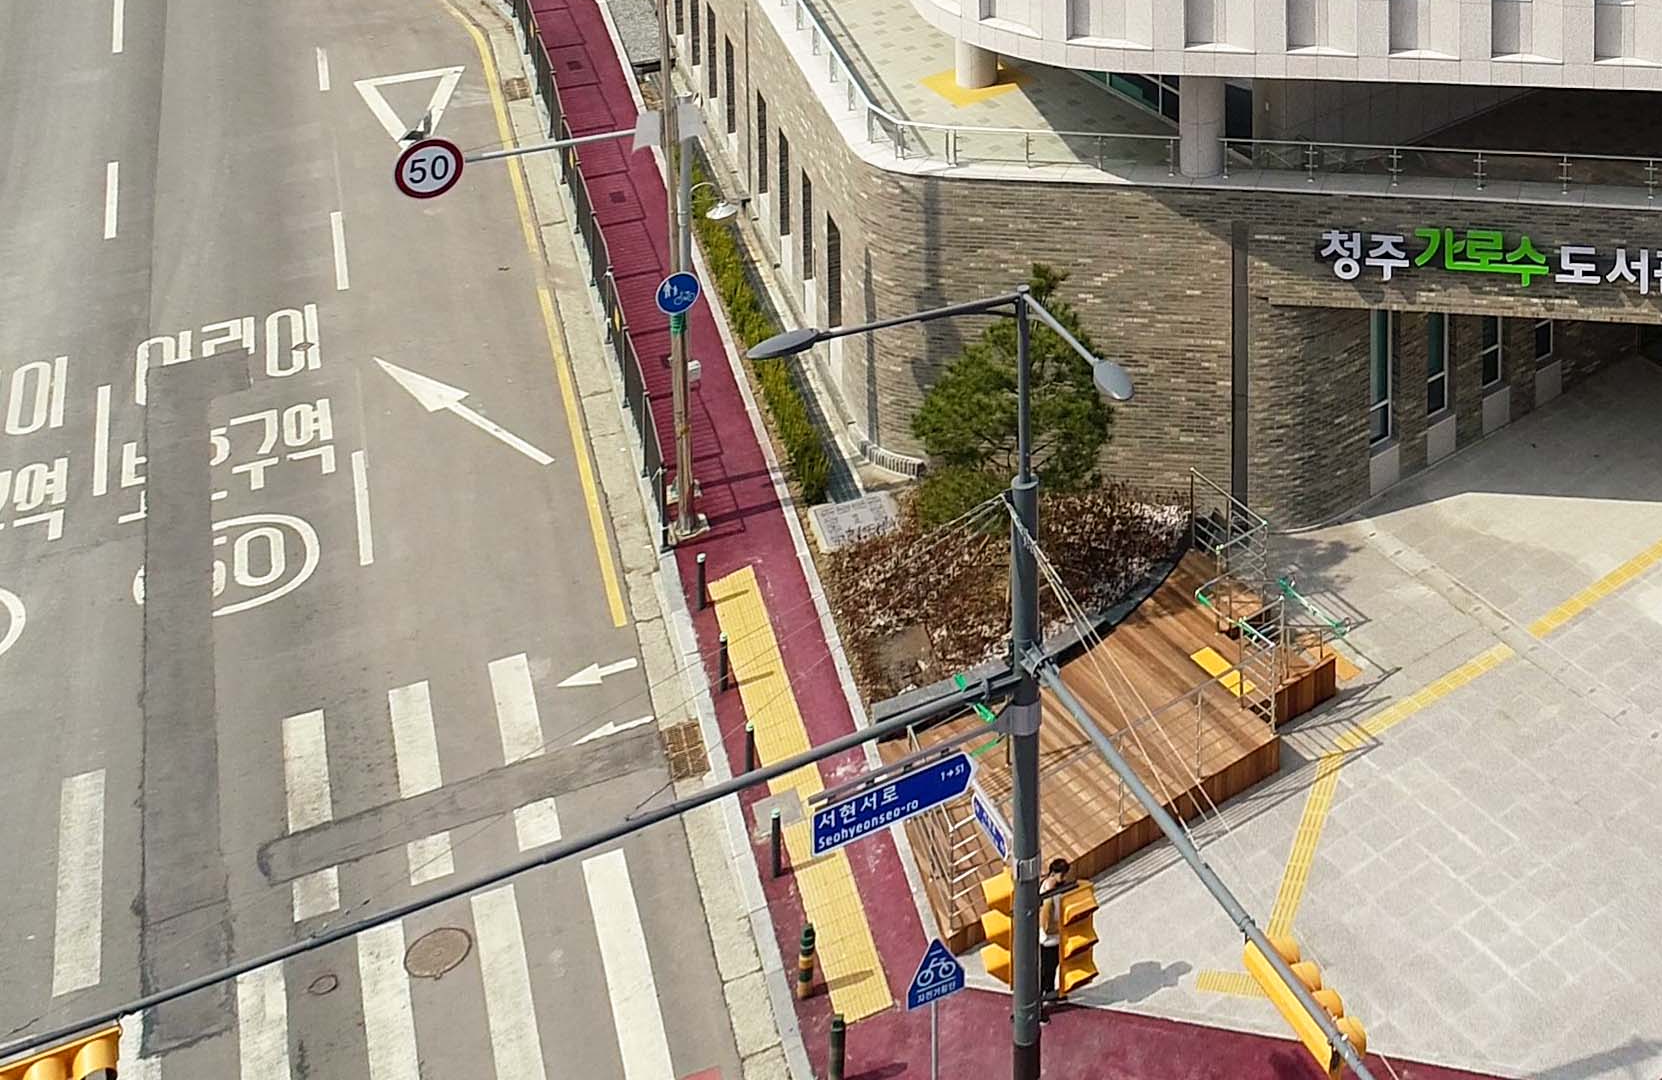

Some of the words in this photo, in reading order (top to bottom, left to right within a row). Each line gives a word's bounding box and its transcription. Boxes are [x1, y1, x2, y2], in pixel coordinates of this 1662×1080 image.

[409, 155, 449, 184] 50
[818, 784, 898, 829] 서현서로
[818, 799, 919, 850] Seohyeonseo-ro
